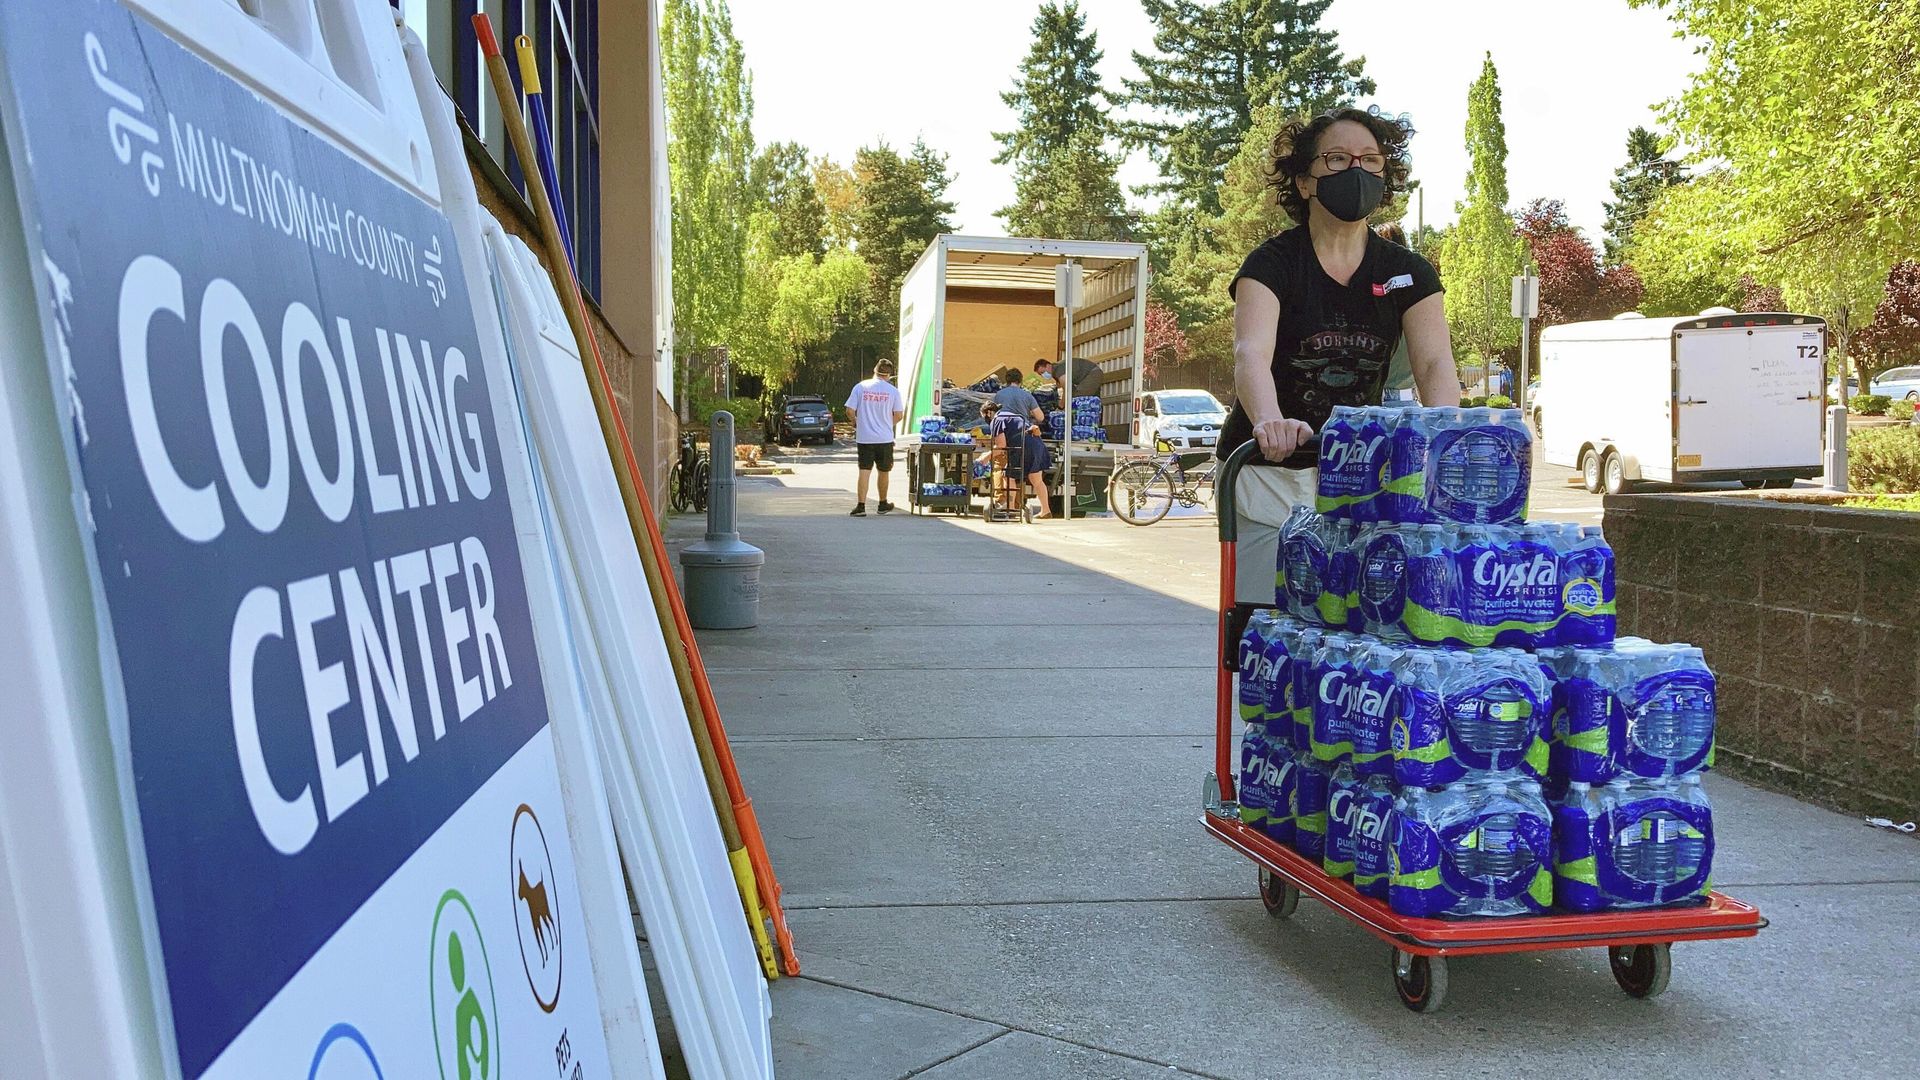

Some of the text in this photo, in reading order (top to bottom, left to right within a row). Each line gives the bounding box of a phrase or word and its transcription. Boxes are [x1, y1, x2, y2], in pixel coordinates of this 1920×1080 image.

[168, 111, 419, 287] MULTNOMAH COUNTY
[1313, 335, 1380, 351] JOHNNY
[1796, 345, 1819, 359] T2
[118, 254, 492, 543] COOLING
[863, 394, 890, 402] STAFF
[1473, 550, 1559, 597] Crystal
[1484, 597, 1519, 611] purified
[229, 538, 513, 856] CENTER
[556, 1027, 571, 1078] PETS
